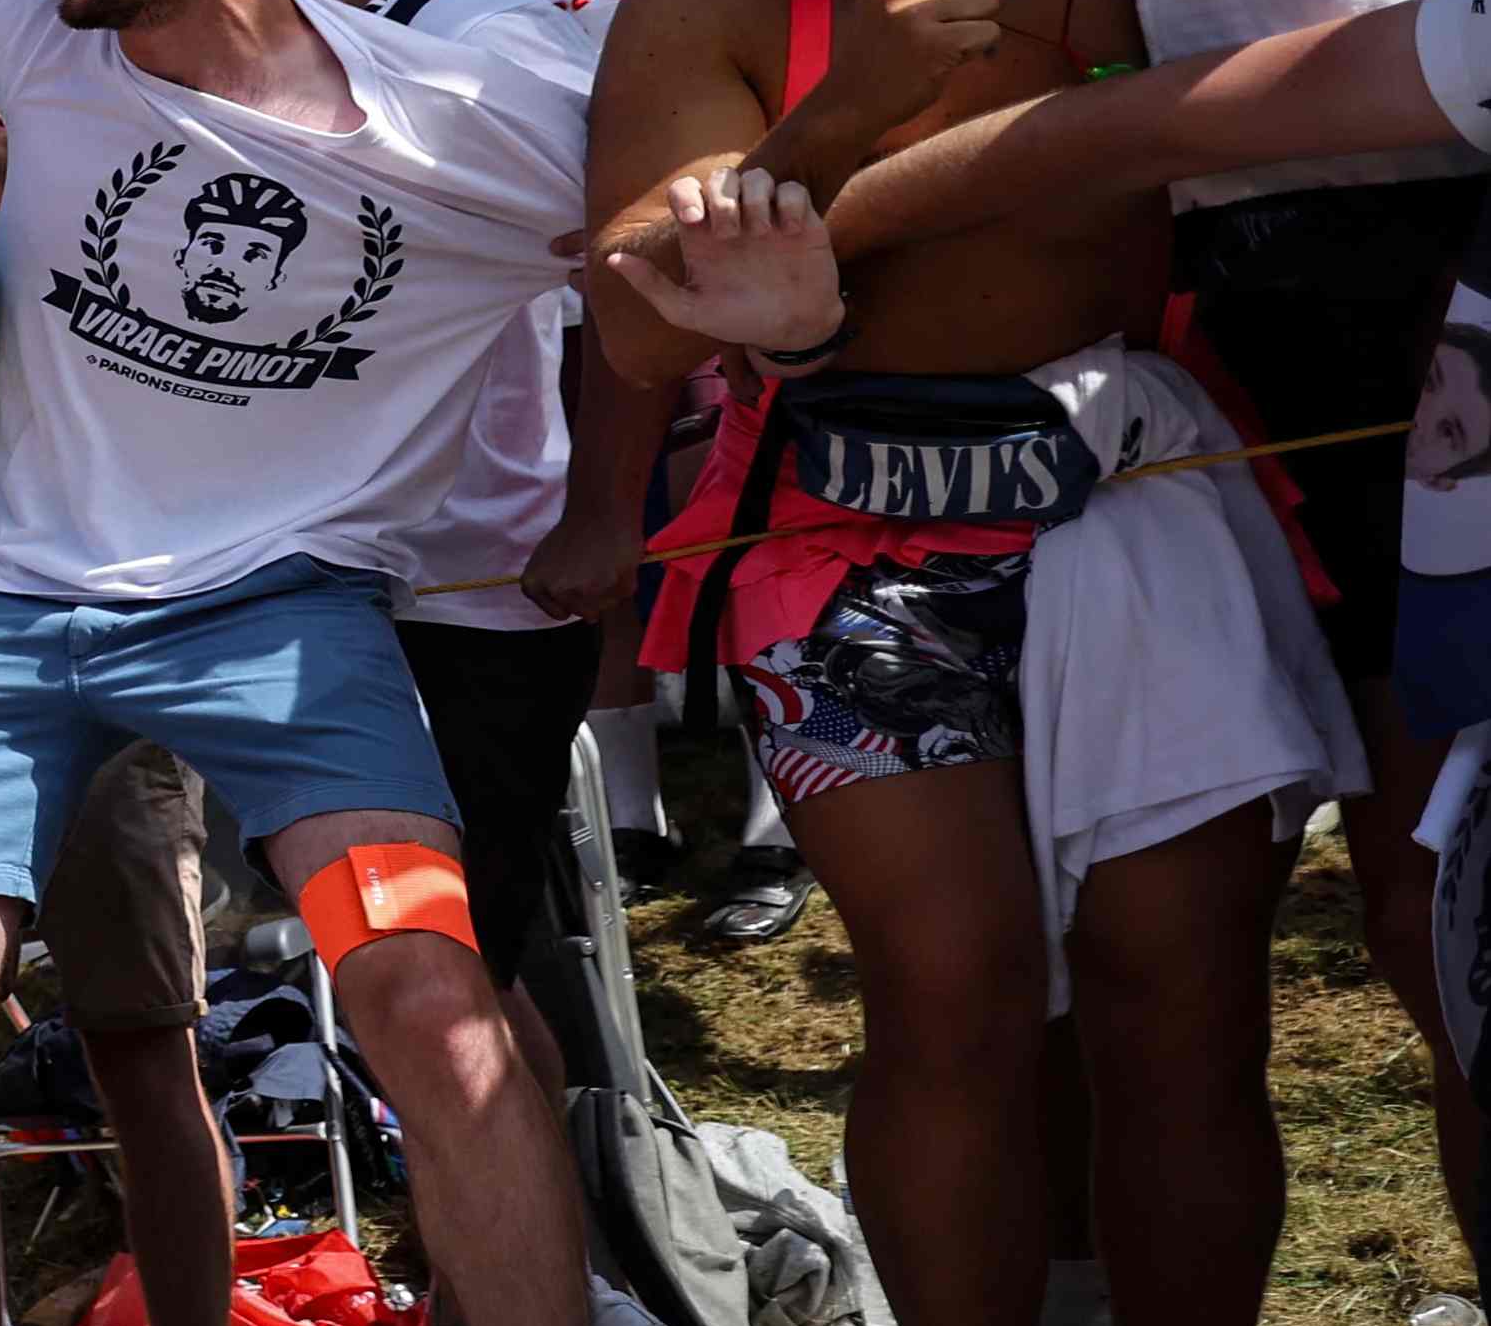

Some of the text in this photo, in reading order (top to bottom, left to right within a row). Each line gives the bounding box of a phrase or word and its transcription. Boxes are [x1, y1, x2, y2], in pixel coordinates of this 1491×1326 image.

[76, 301, 316, 384] VIRAGE PINOT
[99, 358, 249, 406] PARIONS SPORT
[822, 430, 1060, 517] LEVI'S
